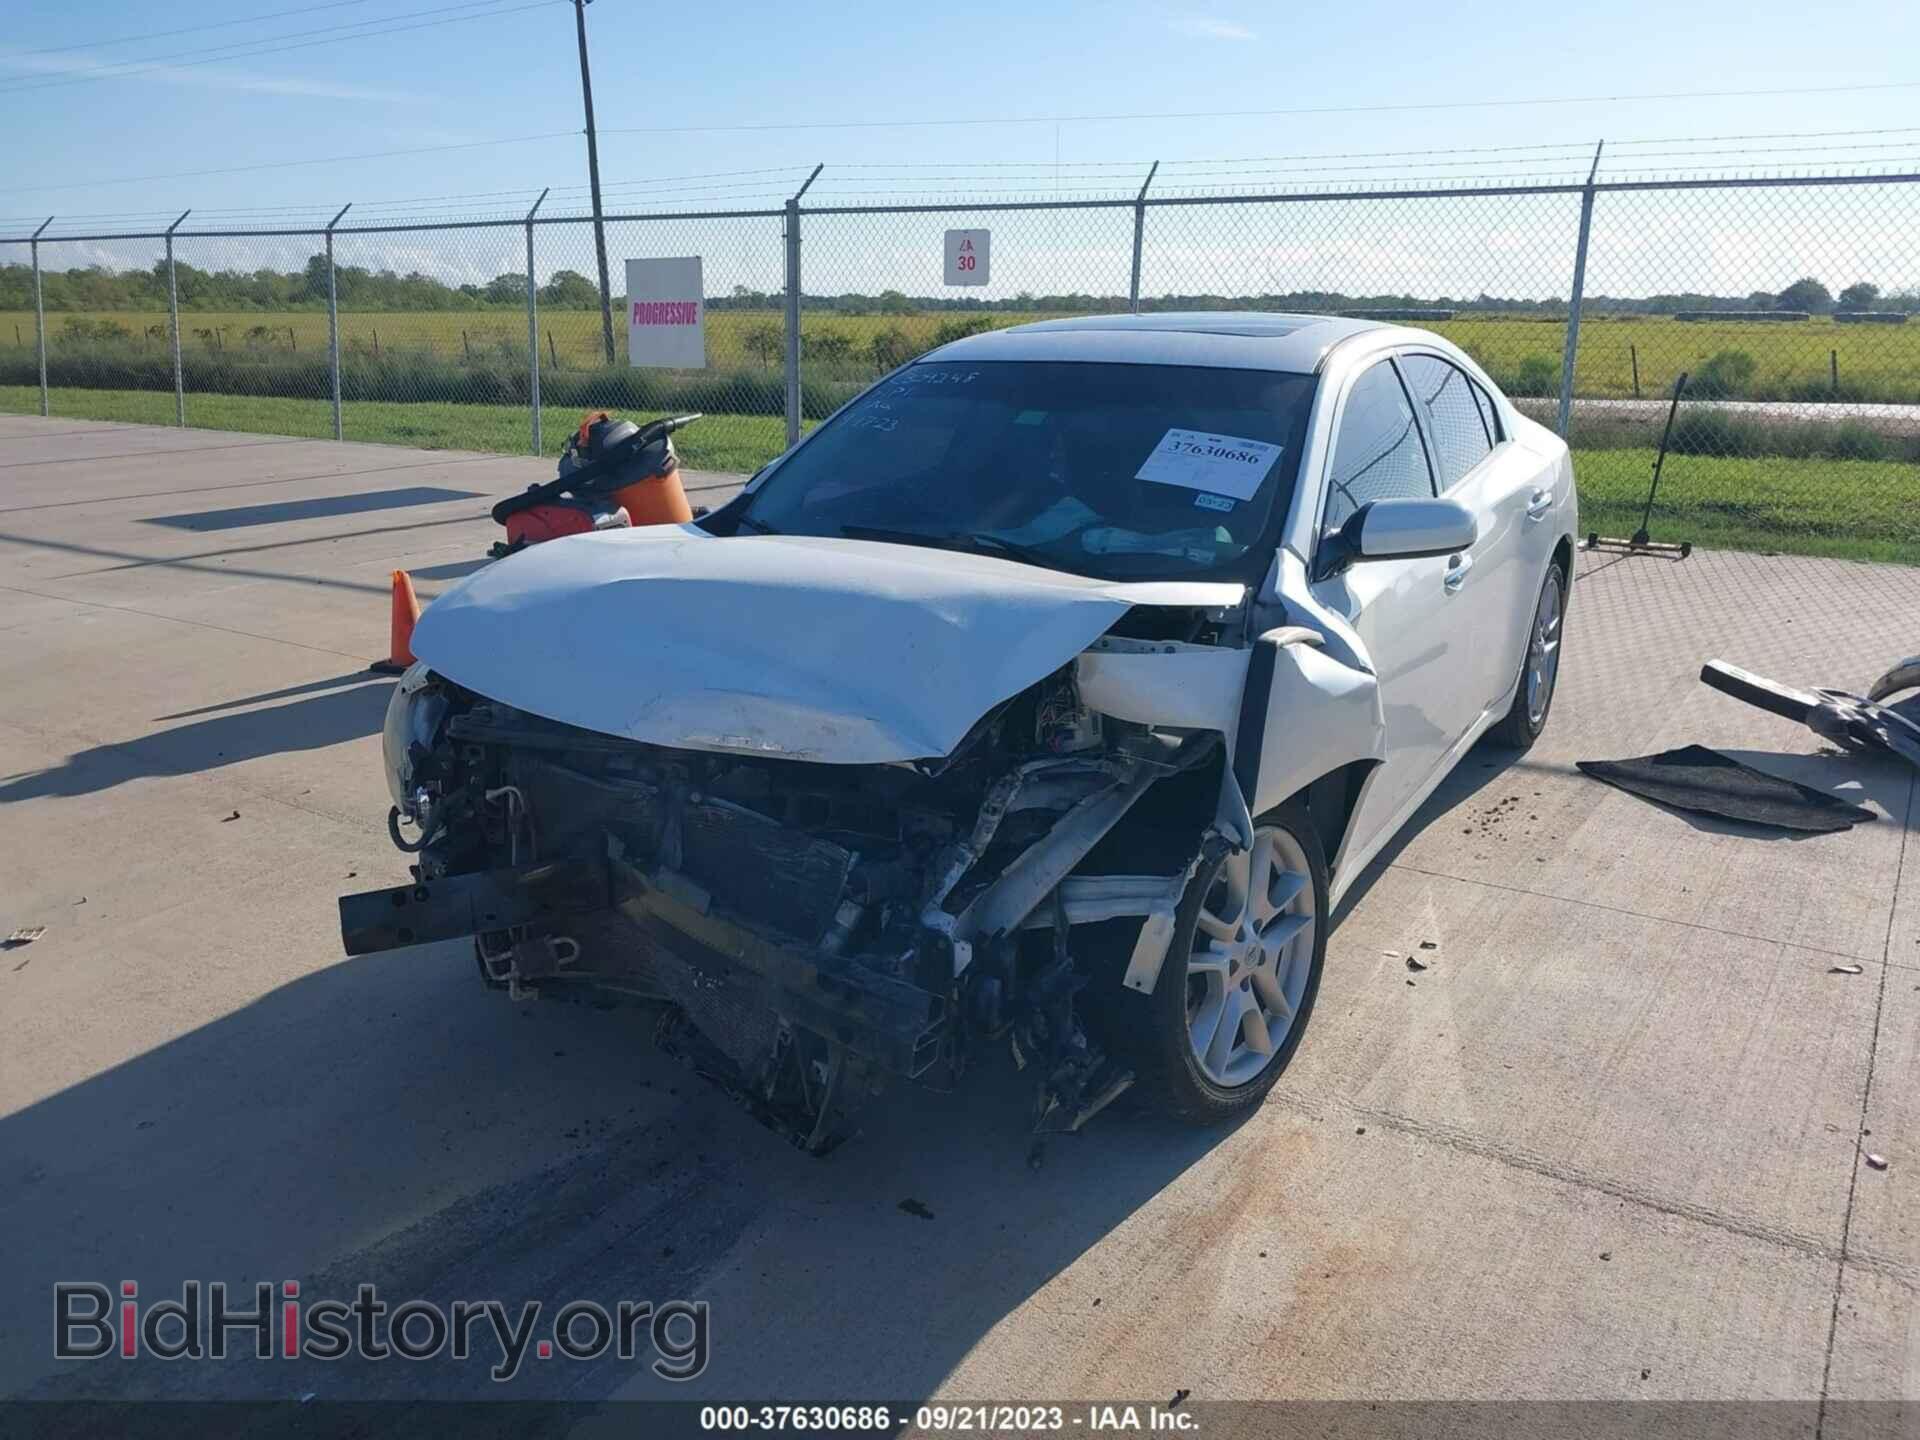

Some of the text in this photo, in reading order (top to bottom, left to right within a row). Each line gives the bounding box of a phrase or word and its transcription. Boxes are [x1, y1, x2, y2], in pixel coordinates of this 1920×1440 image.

[958, 255, 976, 271] 30
[633, 302, 697, 326] PROGRESSIVE
[1167, 440, 1259, 465] 37630686
